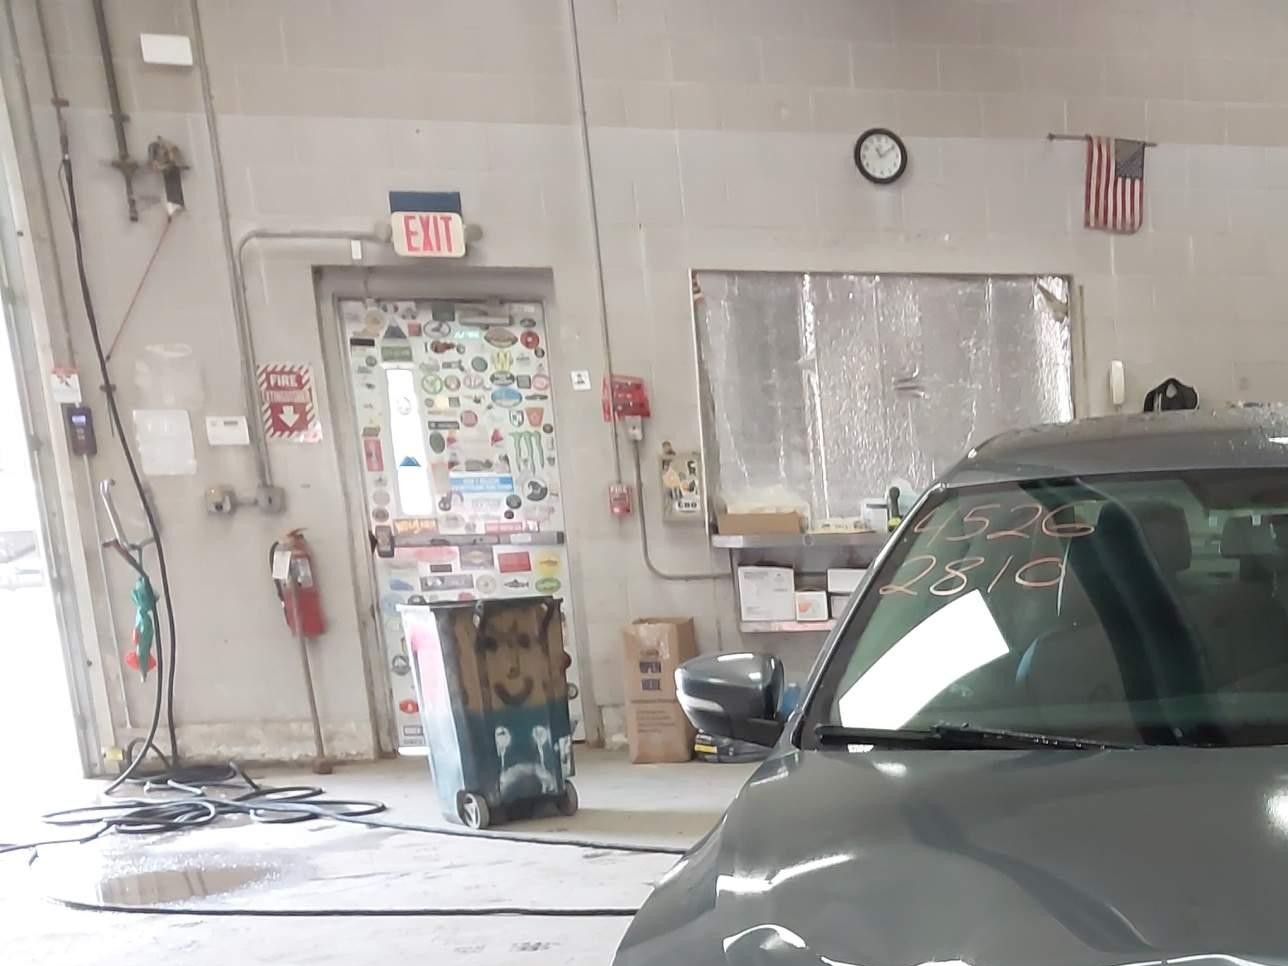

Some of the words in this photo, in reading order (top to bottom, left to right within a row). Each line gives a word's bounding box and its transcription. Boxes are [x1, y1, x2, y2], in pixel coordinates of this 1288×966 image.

[403, 214, 453, 252] EXIT
[269, 374, 298, 387] FIRE
[914, 500, 1096, 547] 4526
